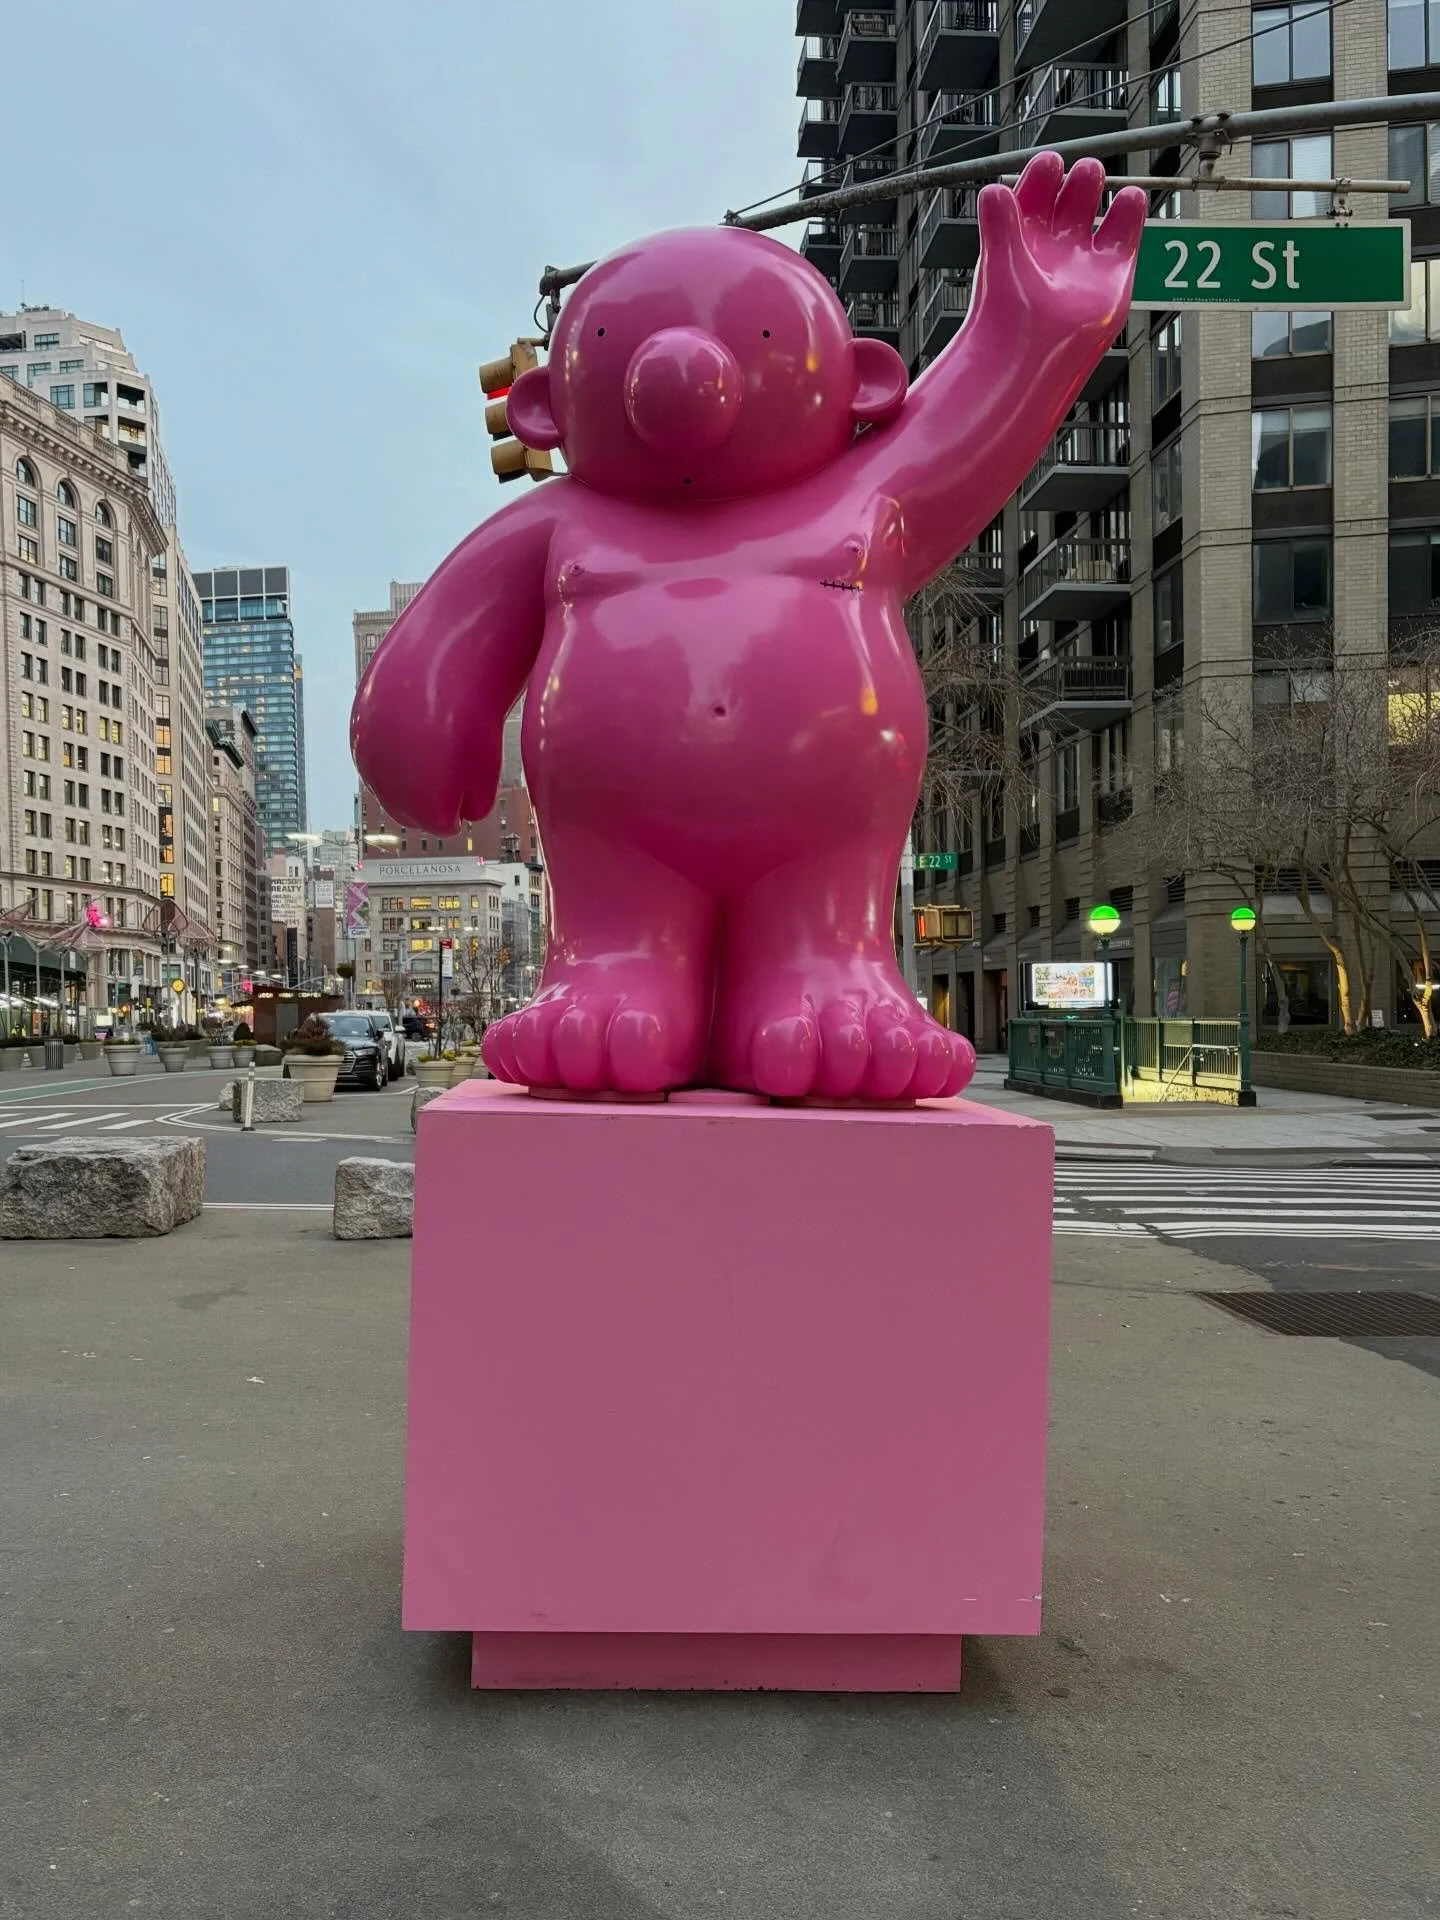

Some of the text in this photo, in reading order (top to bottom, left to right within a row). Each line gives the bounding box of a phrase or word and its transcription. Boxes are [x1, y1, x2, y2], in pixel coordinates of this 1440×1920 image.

[1164, 240, 1300, 290] 22 St
[919, 856, 925, 868] E
[929, 855, 941, 868] 22
[379, 864, 461, 876] PORCELANOSA
